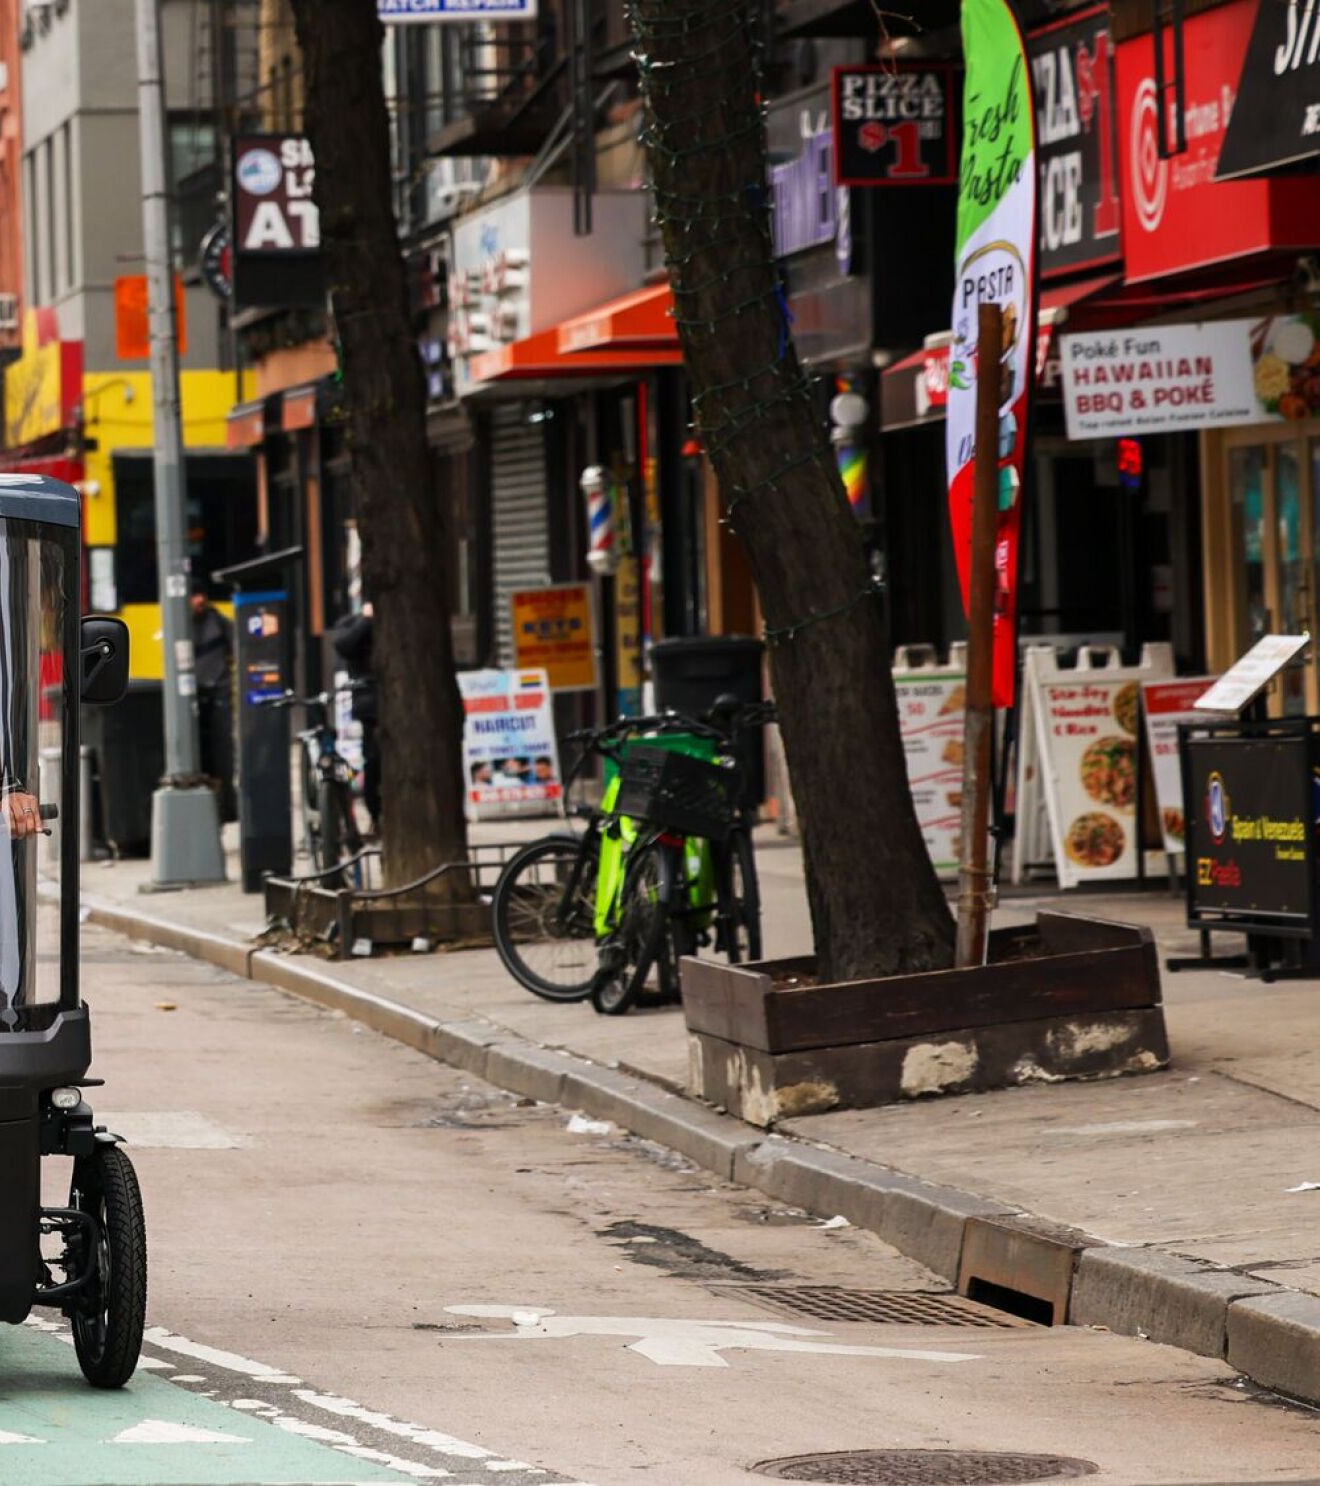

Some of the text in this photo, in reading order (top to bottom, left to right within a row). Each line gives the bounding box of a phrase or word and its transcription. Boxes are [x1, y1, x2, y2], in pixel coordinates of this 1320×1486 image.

[378, 0, 440, 12] ATCH
[842, 74, 940, 97] PIZZA
[1032, 46, 1080, 147] ZA
[842, 97, 943, 120] SLICE
[1040, 151, 1082, 252] CE
[962, 264, 1014, 310] PASTA
[1071, 338, 1118, 360] Poké
[1124, 337, 1161, 356] Fun
[1073, 356, 1214, 387] HAWAIIAN
[1076, 378, 1216, 415] BBQ & POKÉ
[473, 715, 537, 736] HAIRCUT
